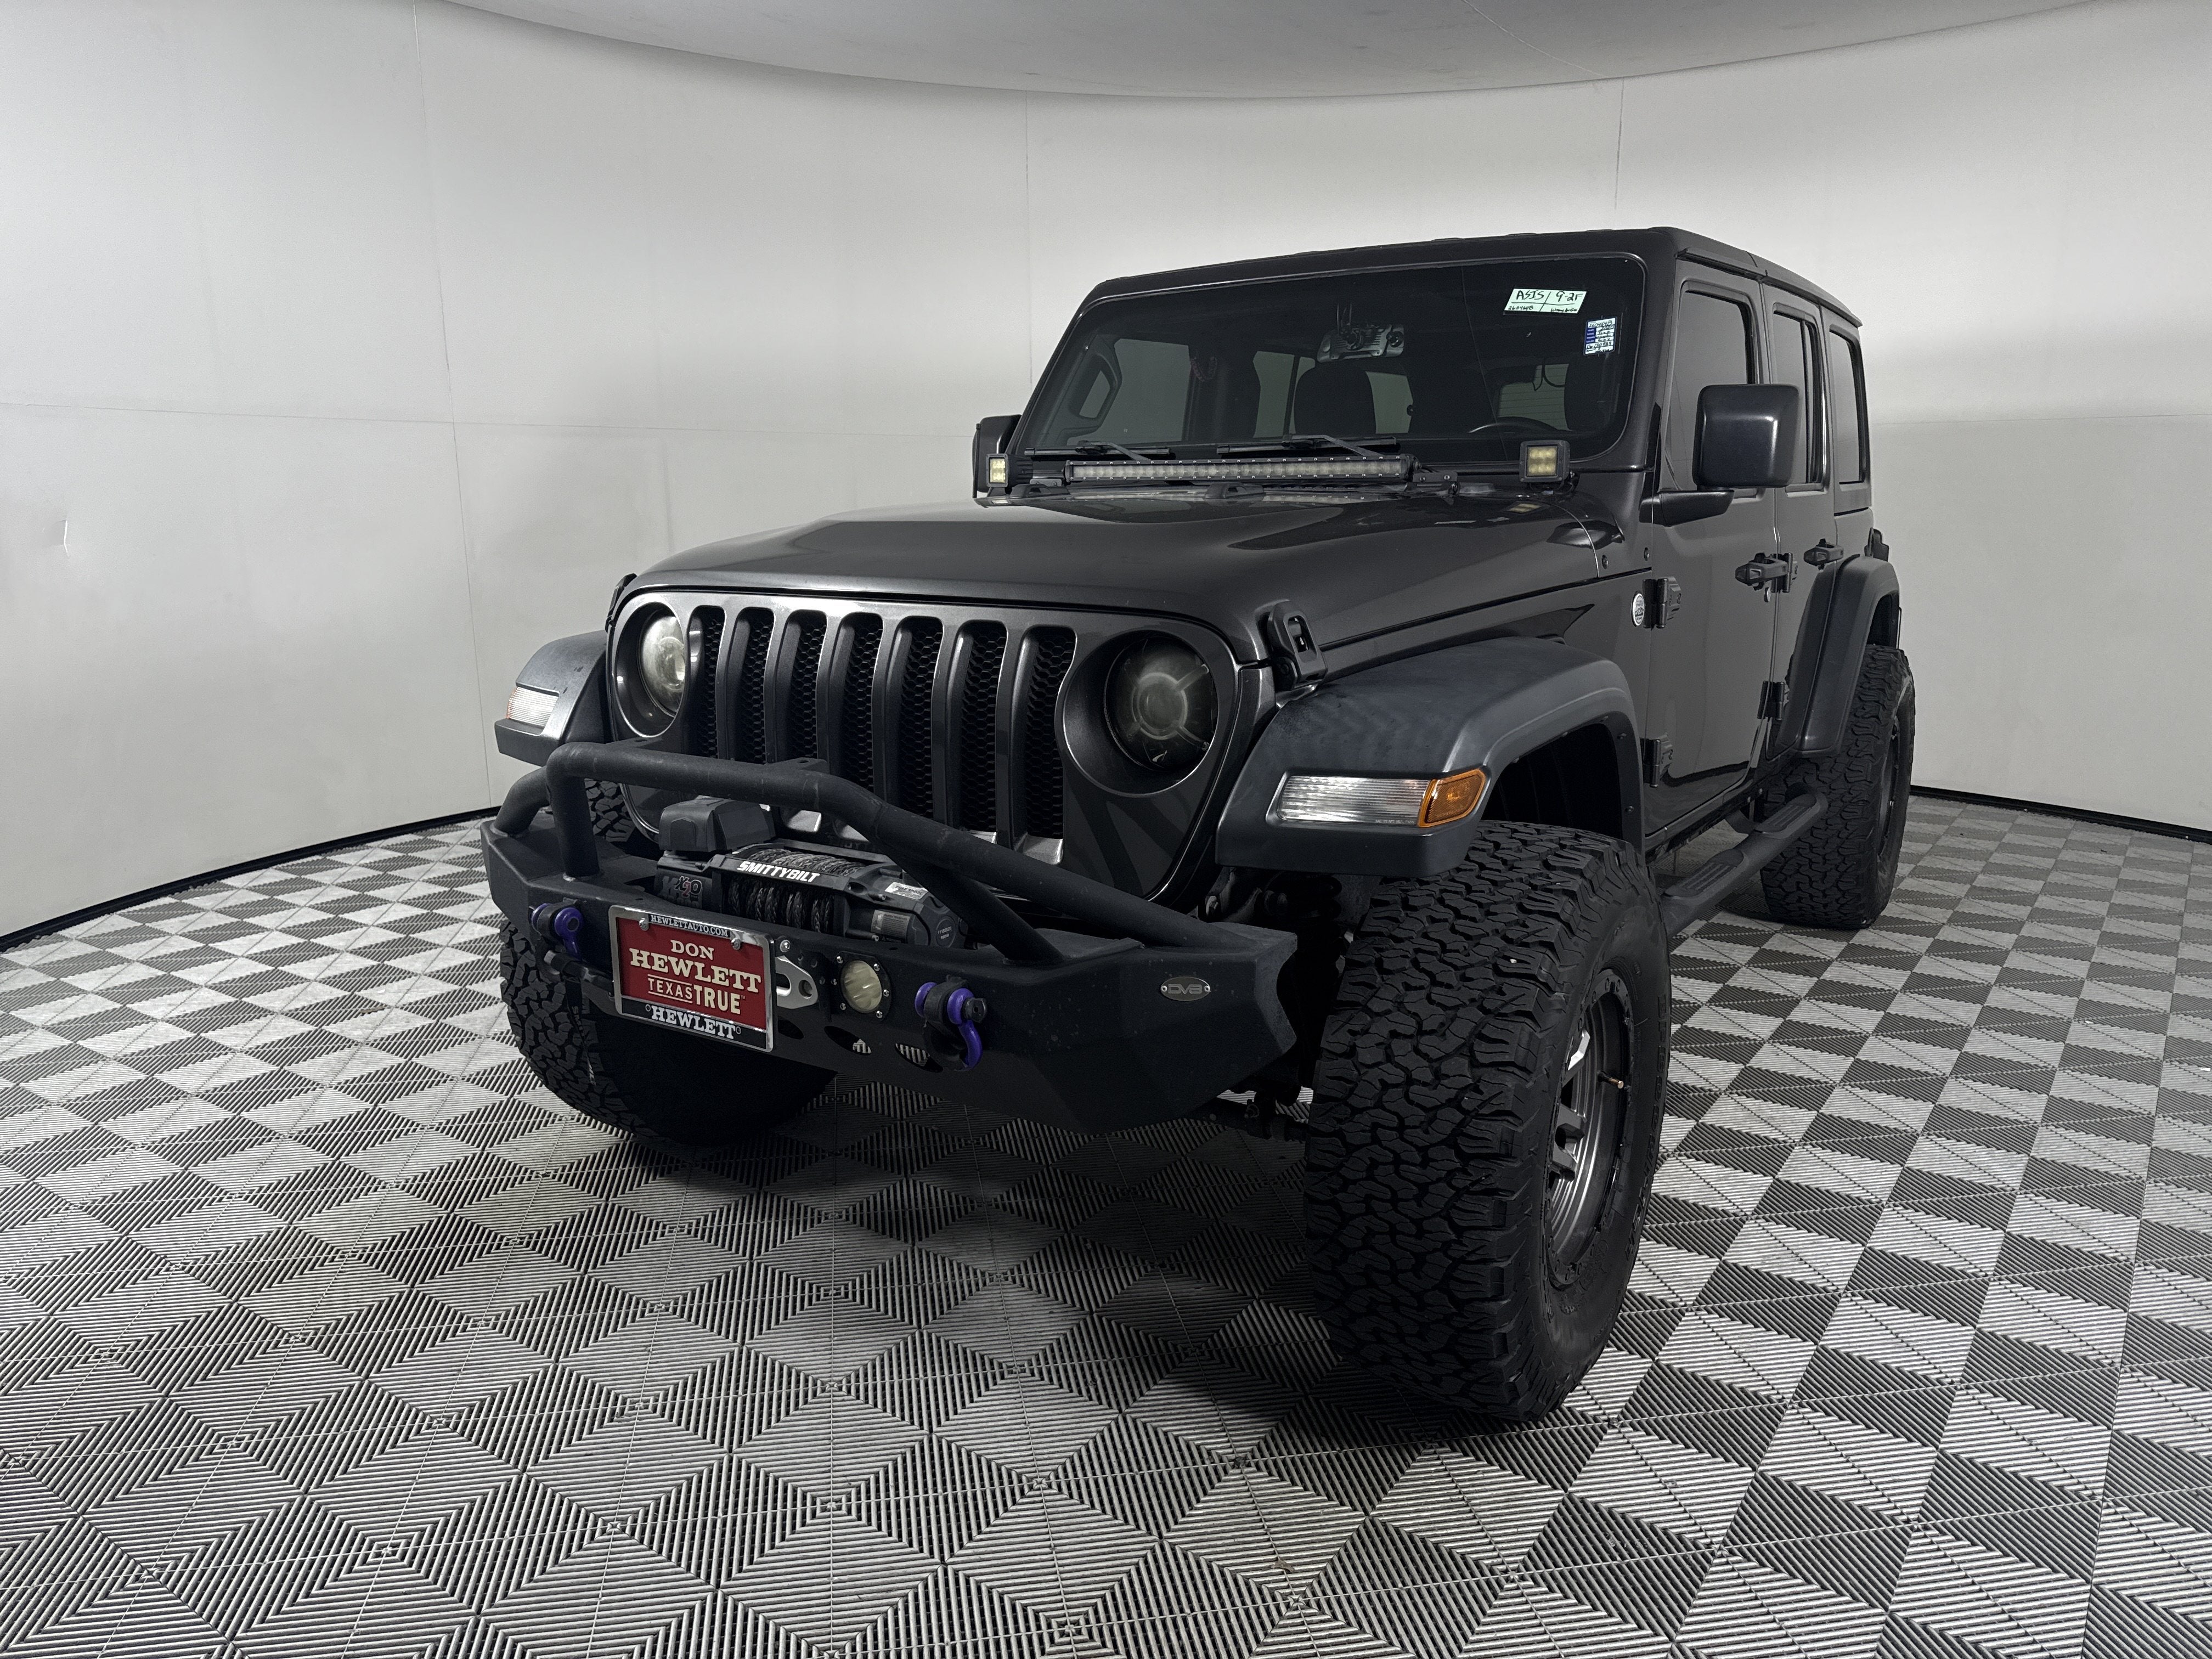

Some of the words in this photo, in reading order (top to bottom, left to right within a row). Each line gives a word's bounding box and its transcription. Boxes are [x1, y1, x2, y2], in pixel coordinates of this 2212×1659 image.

[737, 861, 820, 882] SMITTYBILT
[651, 914, 729, 937] HEWLETTAUTO.COM
[670, 939, 714, 960] DON
[629, 948, 761, 993] HEWLETT
[1168, 984, 1202, 995] DV8
[651, 1006, 736, 1040] HEWLETT
